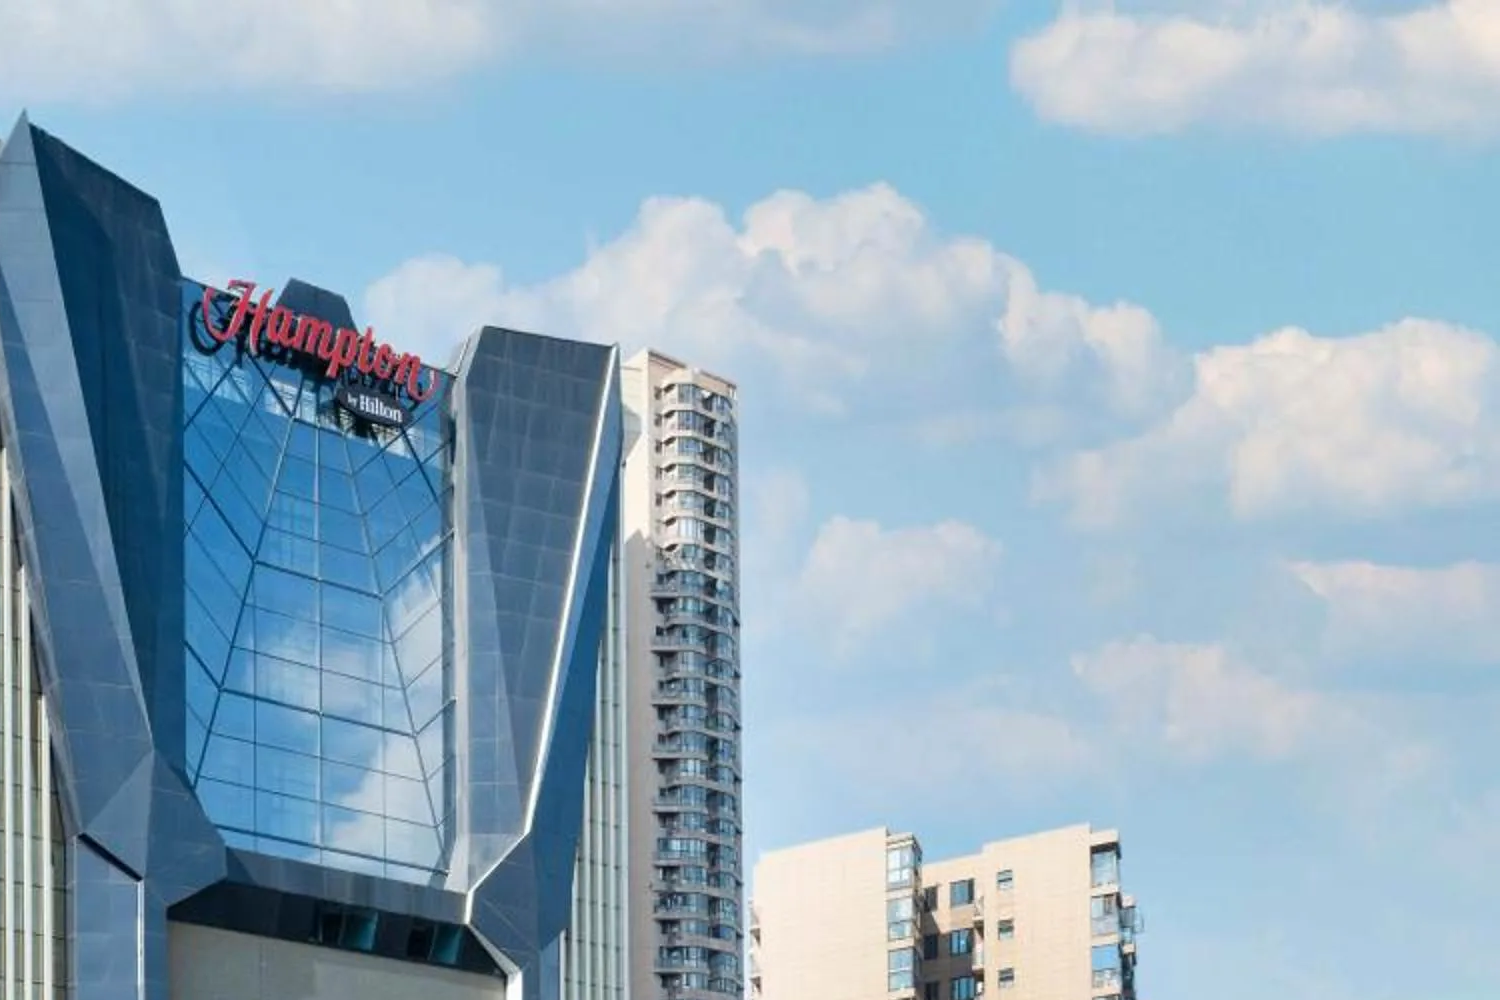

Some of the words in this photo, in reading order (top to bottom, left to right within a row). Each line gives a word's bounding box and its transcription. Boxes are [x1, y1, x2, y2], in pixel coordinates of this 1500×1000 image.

[202, 279, 440, 402] Hampton
[347, 392, 358, 409] by
[359, 394, 403, 423] Hilton
